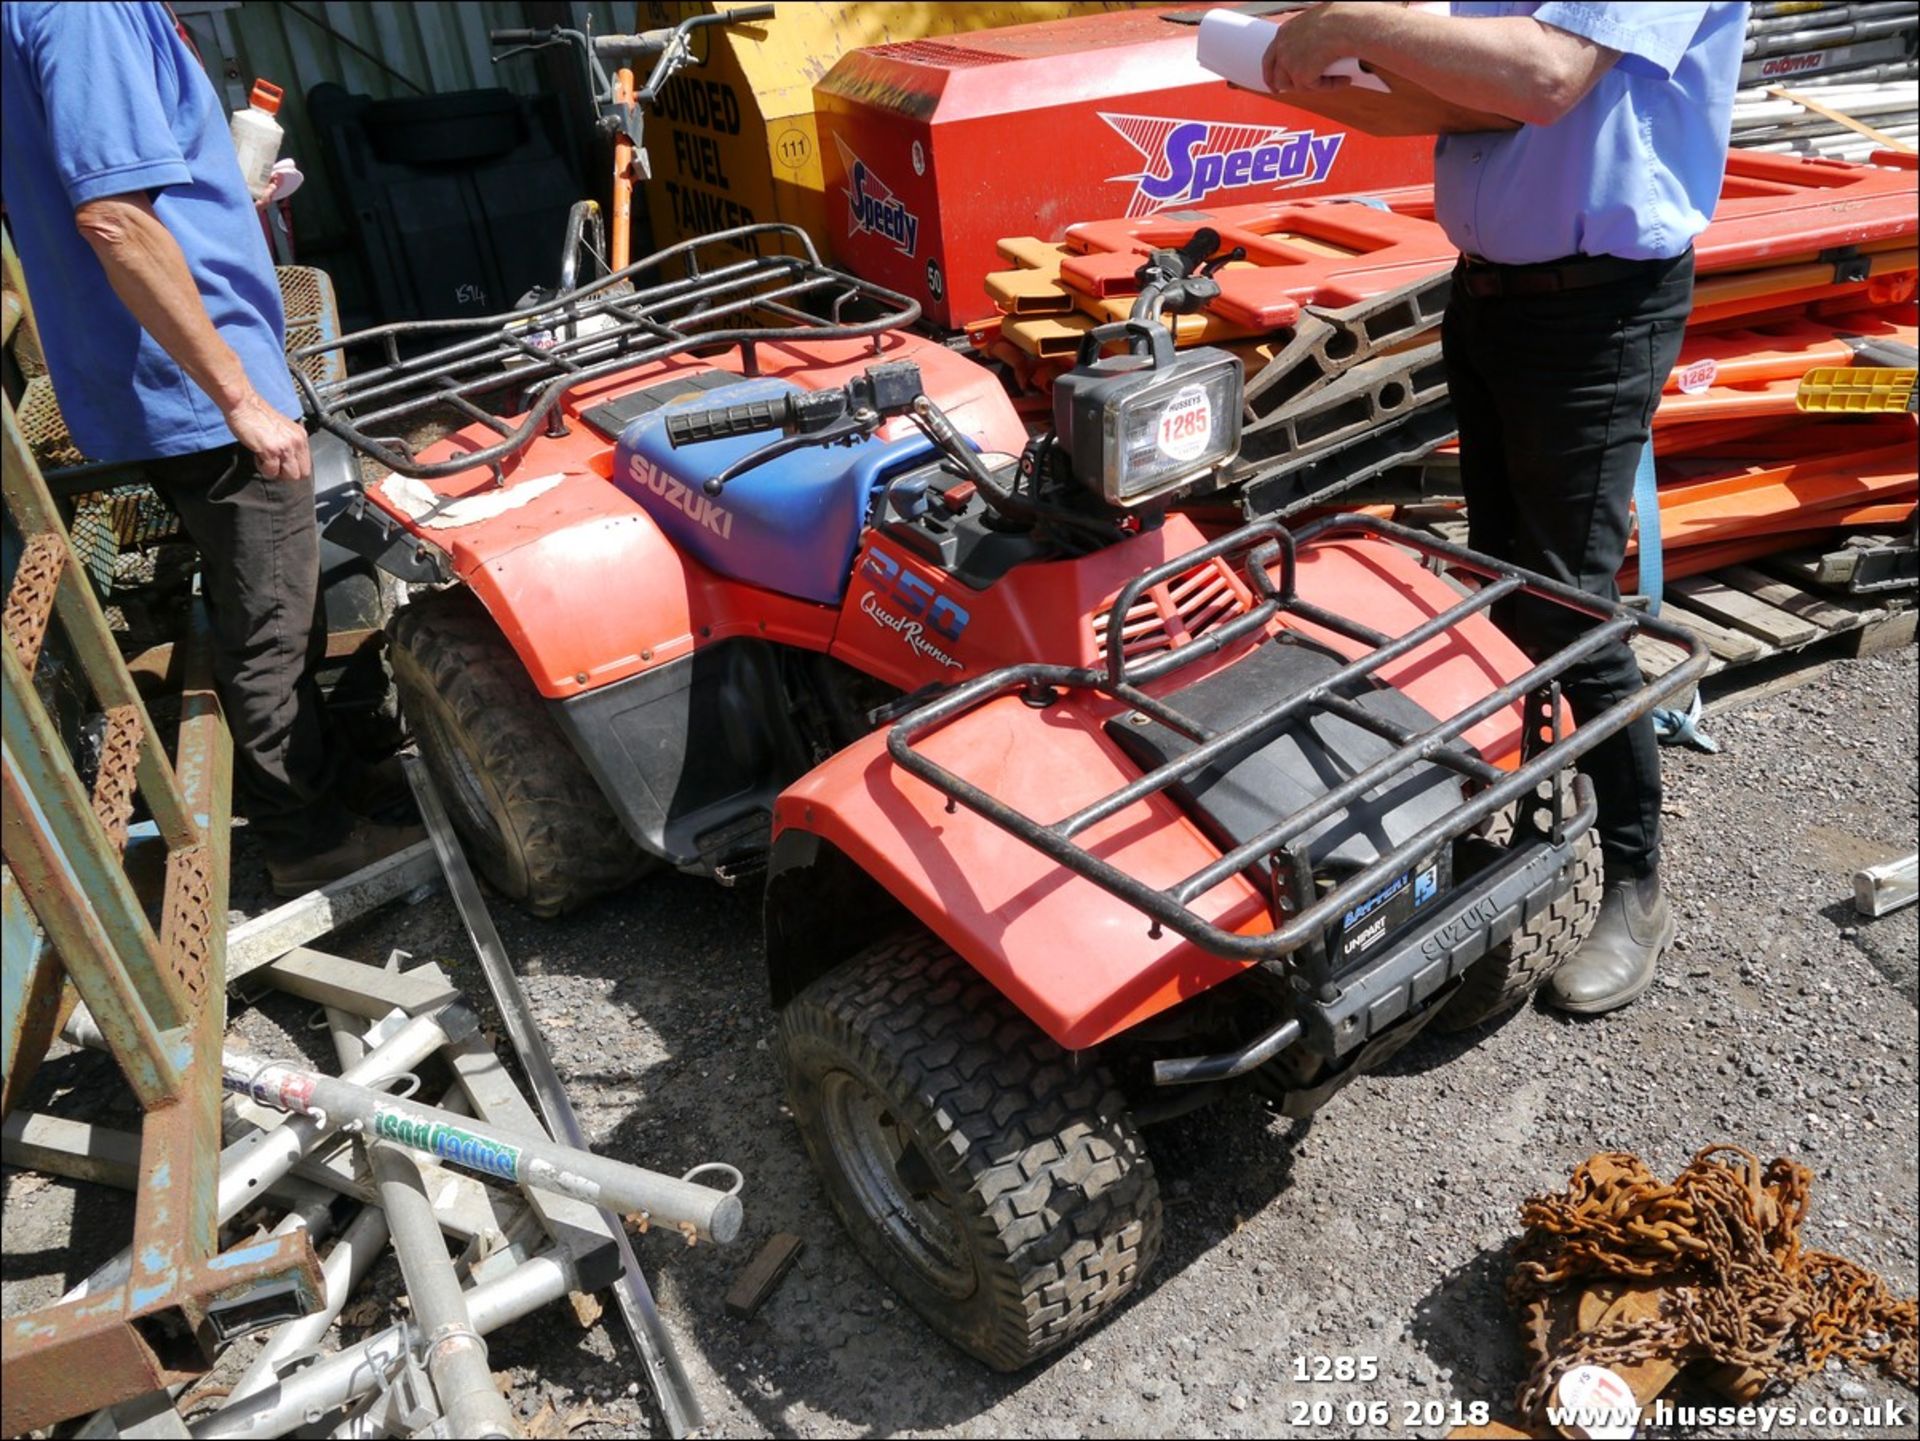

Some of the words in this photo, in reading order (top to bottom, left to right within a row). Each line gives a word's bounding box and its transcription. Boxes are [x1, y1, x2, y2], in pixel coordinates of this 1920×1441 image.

[672, 129, 731, 190] FUEL
[781, 138, 805, 158] 111
[1140, 122, 1344, 200] Speedy
[665, 180, 760, 258] TANKER
[850, 160, 918, 256] Speedy
[927, 266, 942, 293] 50
[1168, 394, 1202, 412] HUSSEYS
[1683, 366, 1714, 387] 1282
[1162, 406, 1207, 444] 1285
[628, 453, 733, 540] SUZUKI
[861, 546, 970, 642] 250
[1344, 914, 1387, 954] UNIPART
[1420, 896, 1499, 962] SUZUKI
